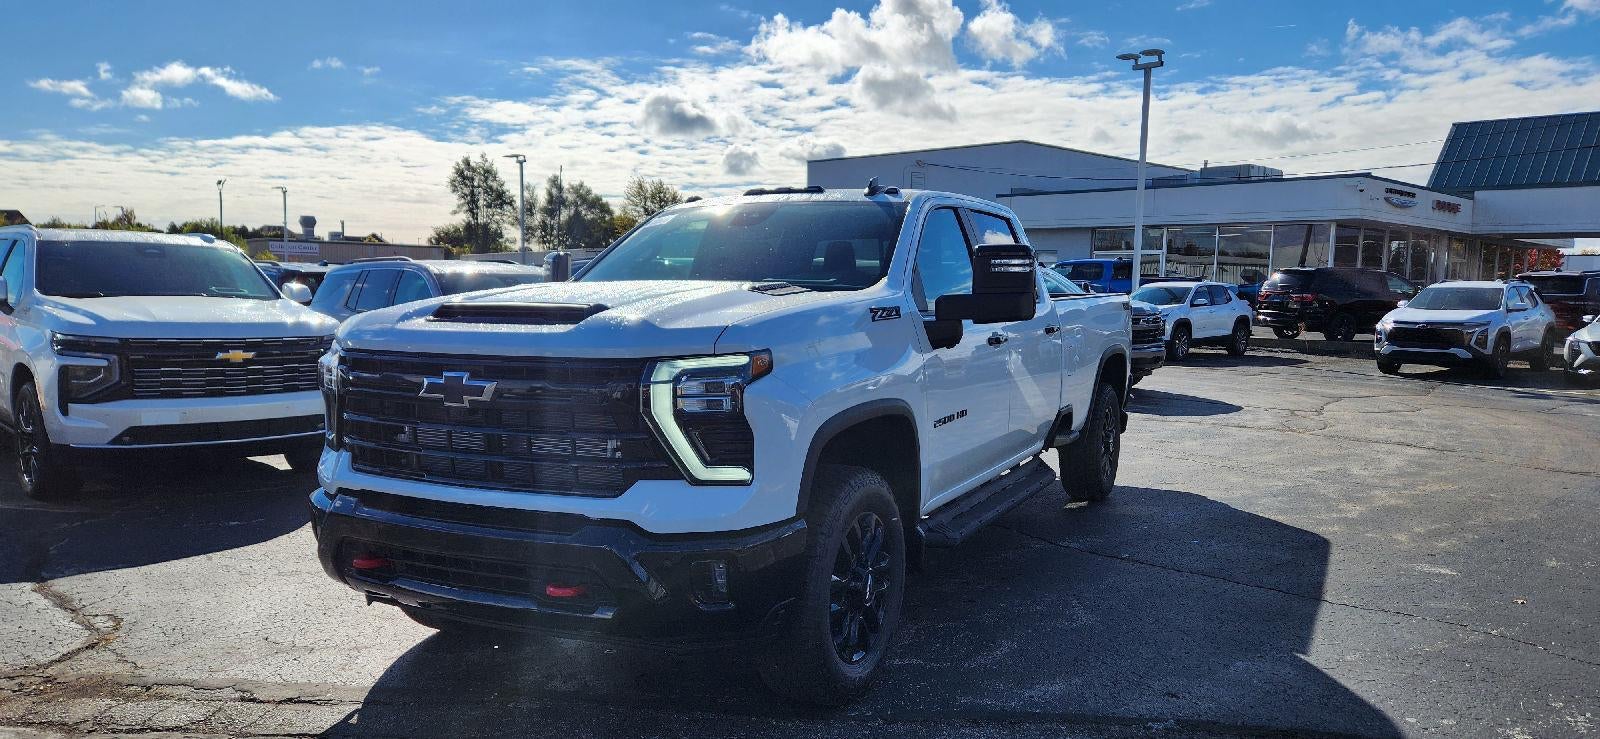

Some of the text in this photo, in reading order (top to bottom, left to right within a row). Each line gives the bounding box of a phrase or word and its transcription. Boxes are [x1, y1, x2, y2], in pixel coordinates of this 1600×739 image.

[869, 305, 901, 322] Z71
[933, 409, 968, 428] 2500 HD
